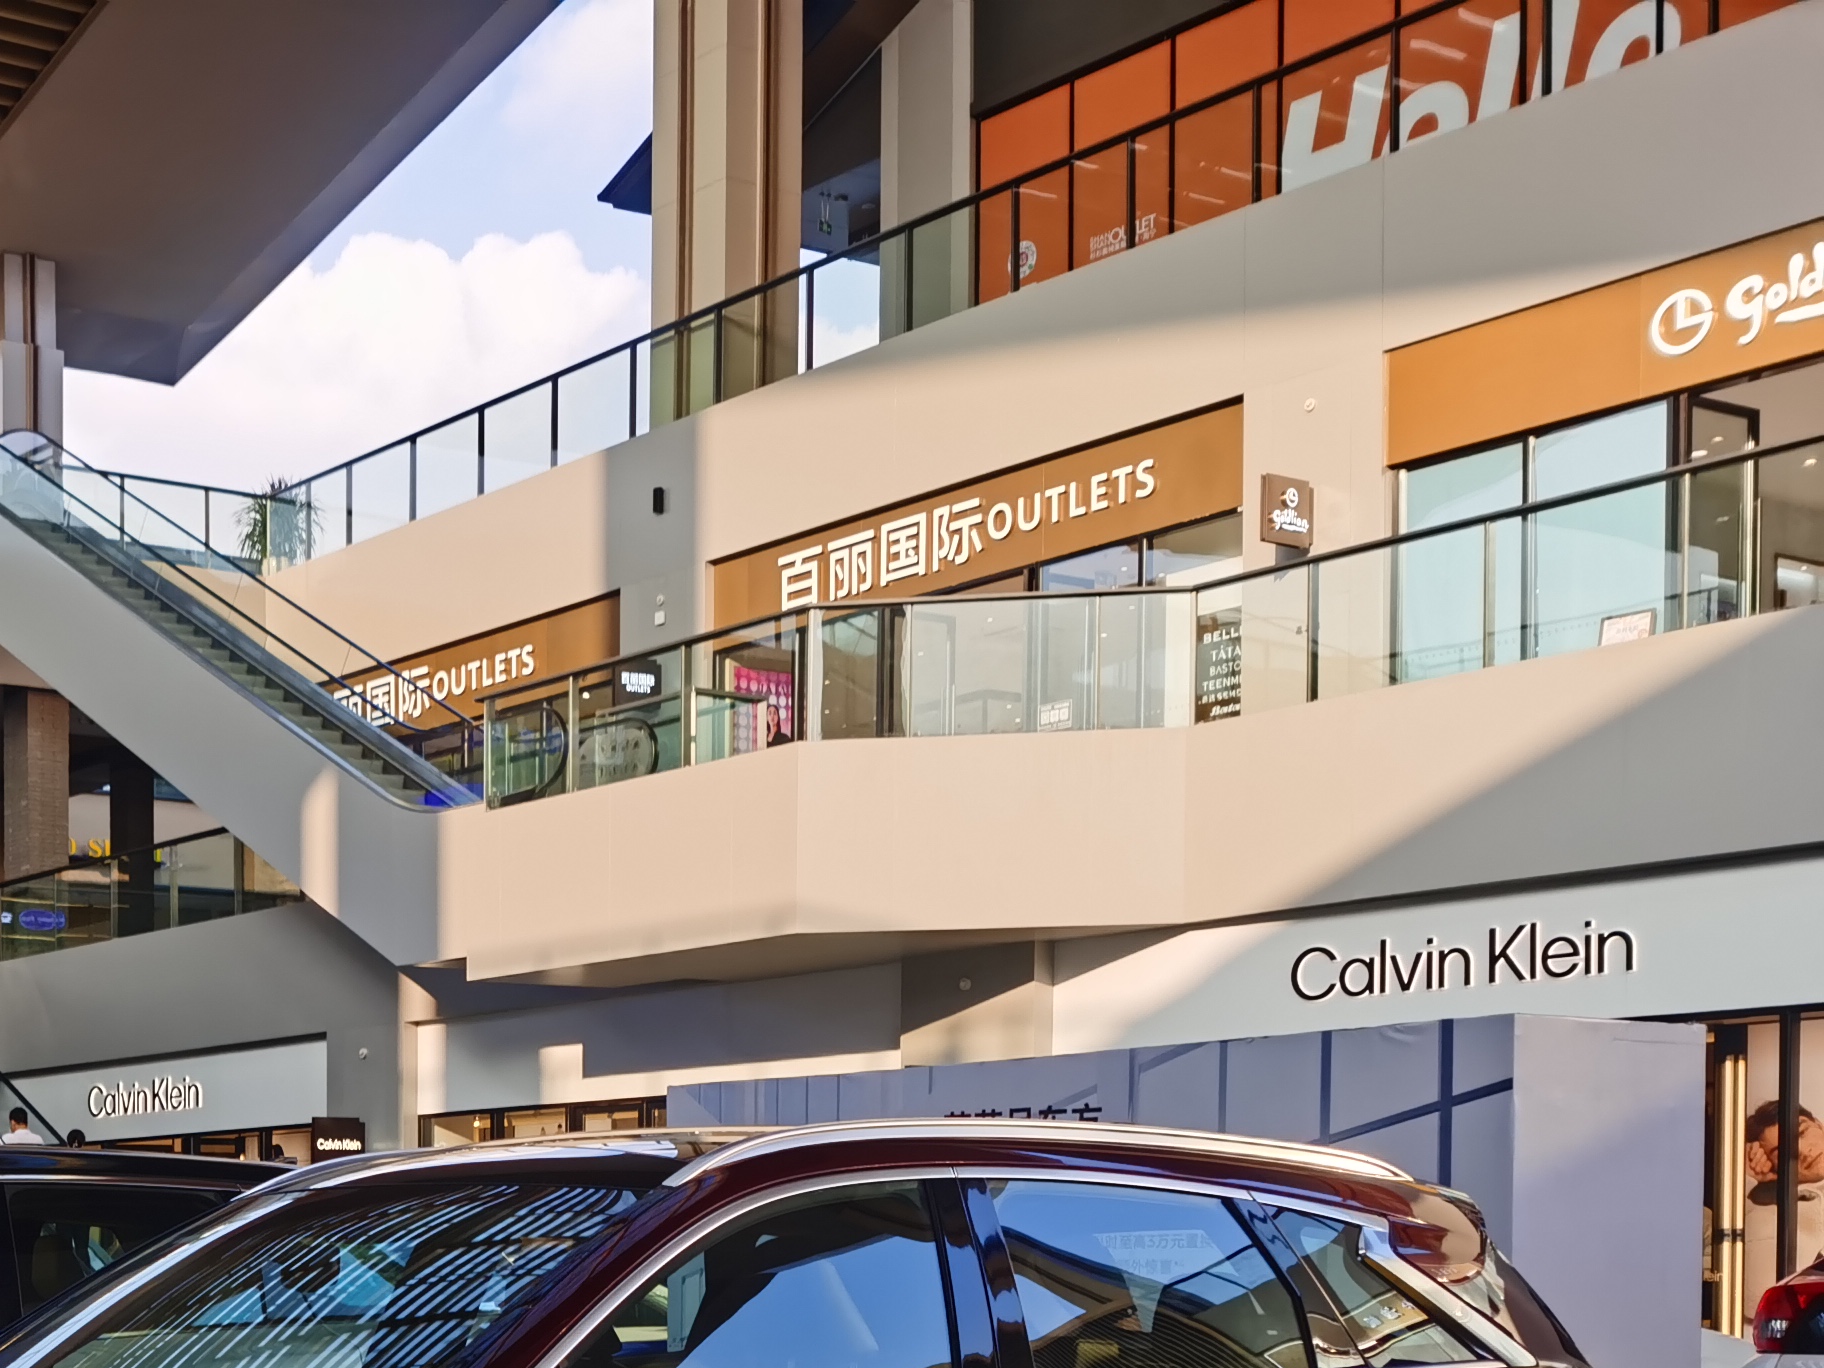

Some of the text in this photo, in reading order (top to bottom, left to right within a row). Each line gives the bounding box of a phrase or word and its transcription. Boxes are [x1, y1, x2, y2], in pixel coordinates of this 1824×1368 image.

[778, 459, 1155, 612] 百丽国际 OUTLETS
[432, 644, 535, 701] OUTLETS
[1291, 920, 1636, 1001] Calvin Klein
[88, 1076, 203, 1118] Calvin Klein
[316, 1138, 362, 1152] Calvin Klein
